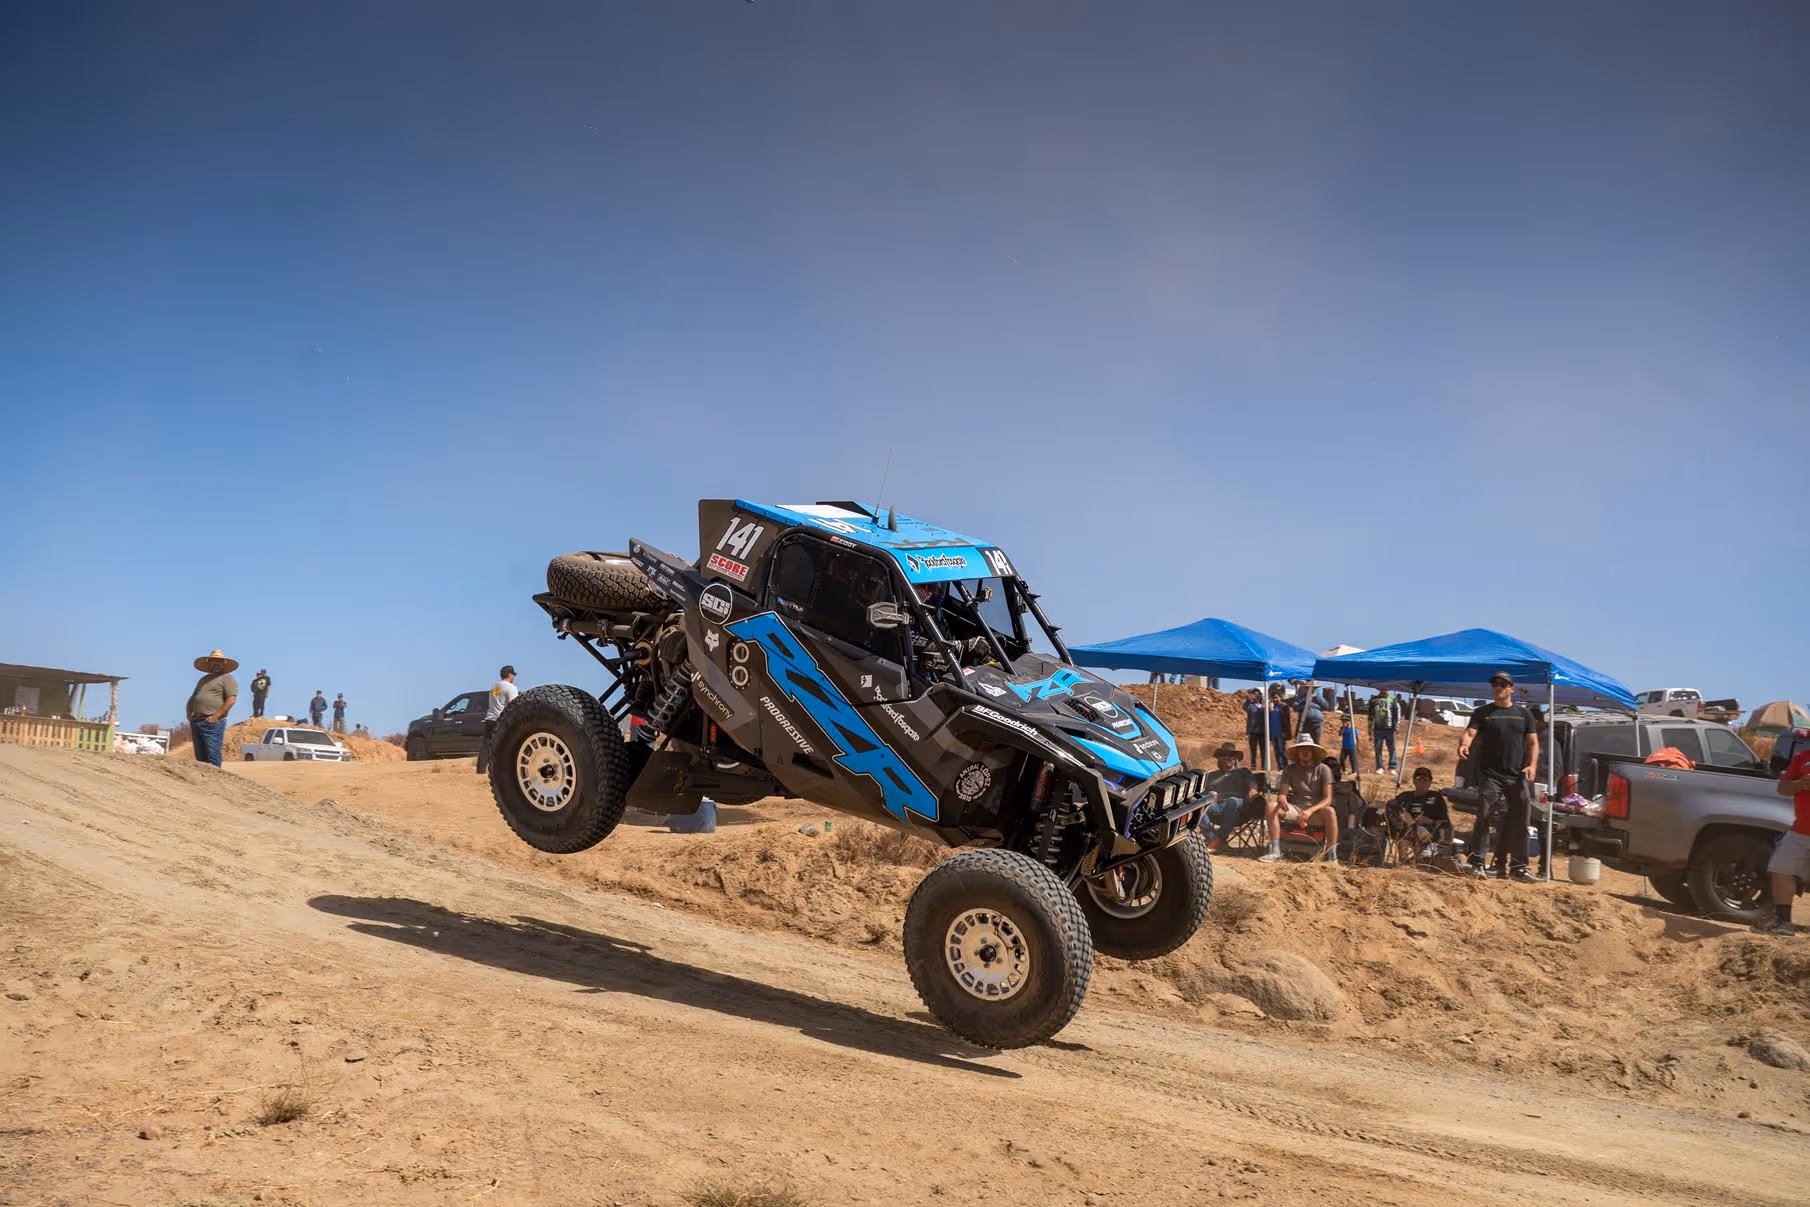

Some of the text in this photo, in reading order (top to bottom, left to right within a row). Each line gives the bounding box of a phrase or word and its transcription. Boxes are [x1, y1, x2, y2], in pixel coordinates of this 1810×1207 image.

[716, 516, 764, 560] 141
[710, 555, 748, 577] SCORE
[984, 550, 1013, 575] 141
[697, 680, 733, 719] synchrony
[760, 696, 815, 755] PROGRESSIVE
[974, 704, 1039, 736] BFGoodrich
